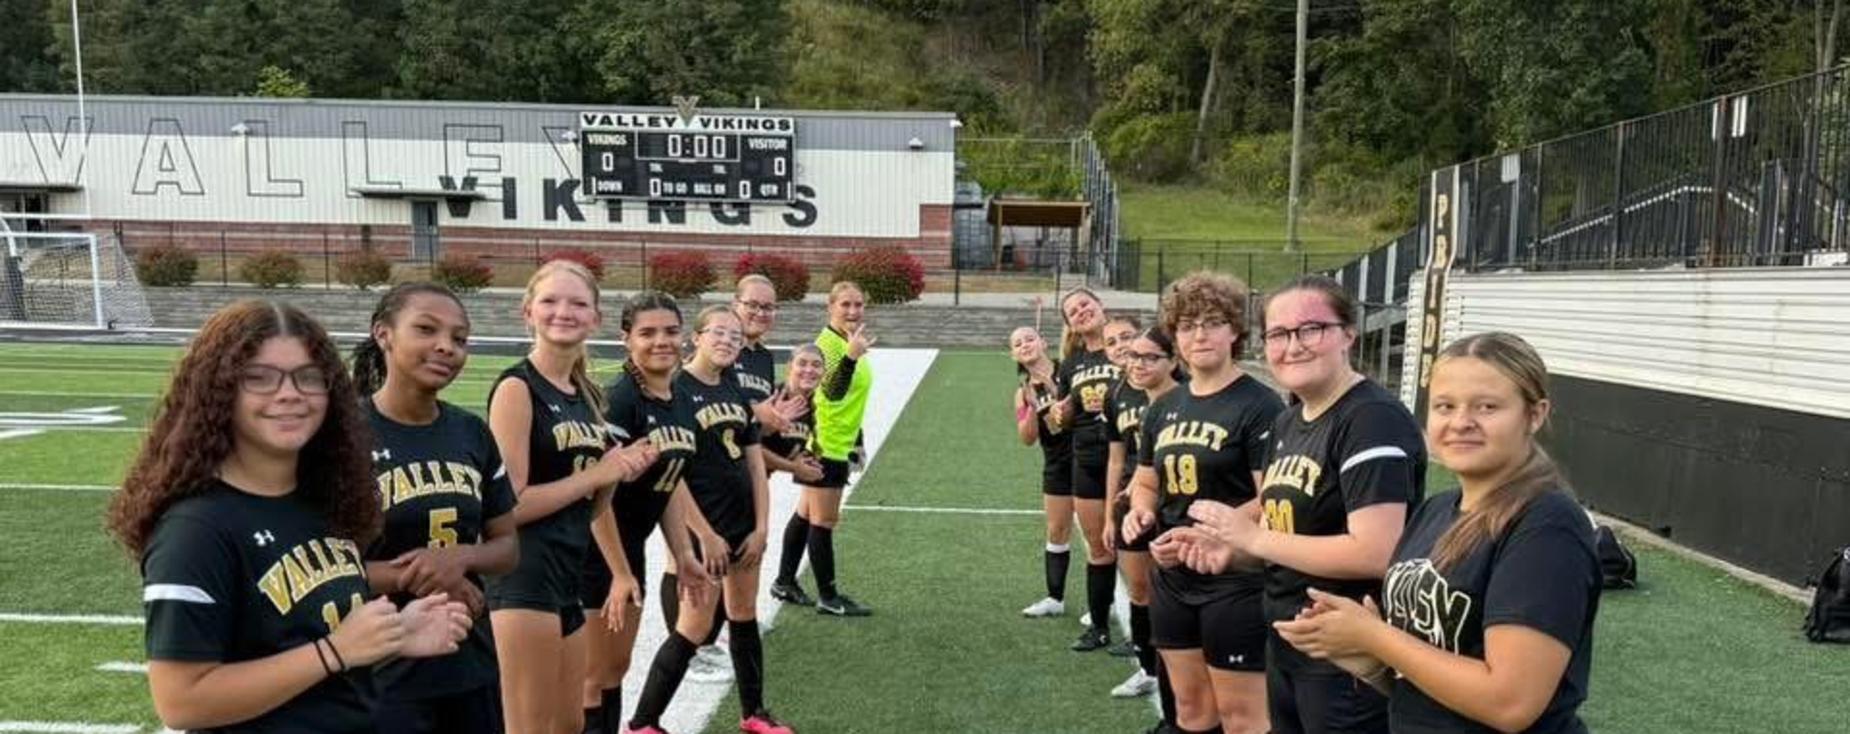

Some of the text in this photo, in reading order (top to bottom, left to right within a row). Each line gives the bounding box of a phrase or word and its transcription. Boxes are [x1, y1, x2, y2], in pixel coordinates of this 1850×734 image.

[583, 114, 791, 131] VALLEY VIKINGS
[668, 134, 726, 158] 0:00
[747, 138, 788, 151] VISITOR
[602, 152, 614, 172] 0
[774, 157, 786, 176] 0
[650, 178, 661, 196] 0
[739, 180, 751, 199] 0
[427, 506, 458, 550] 5
